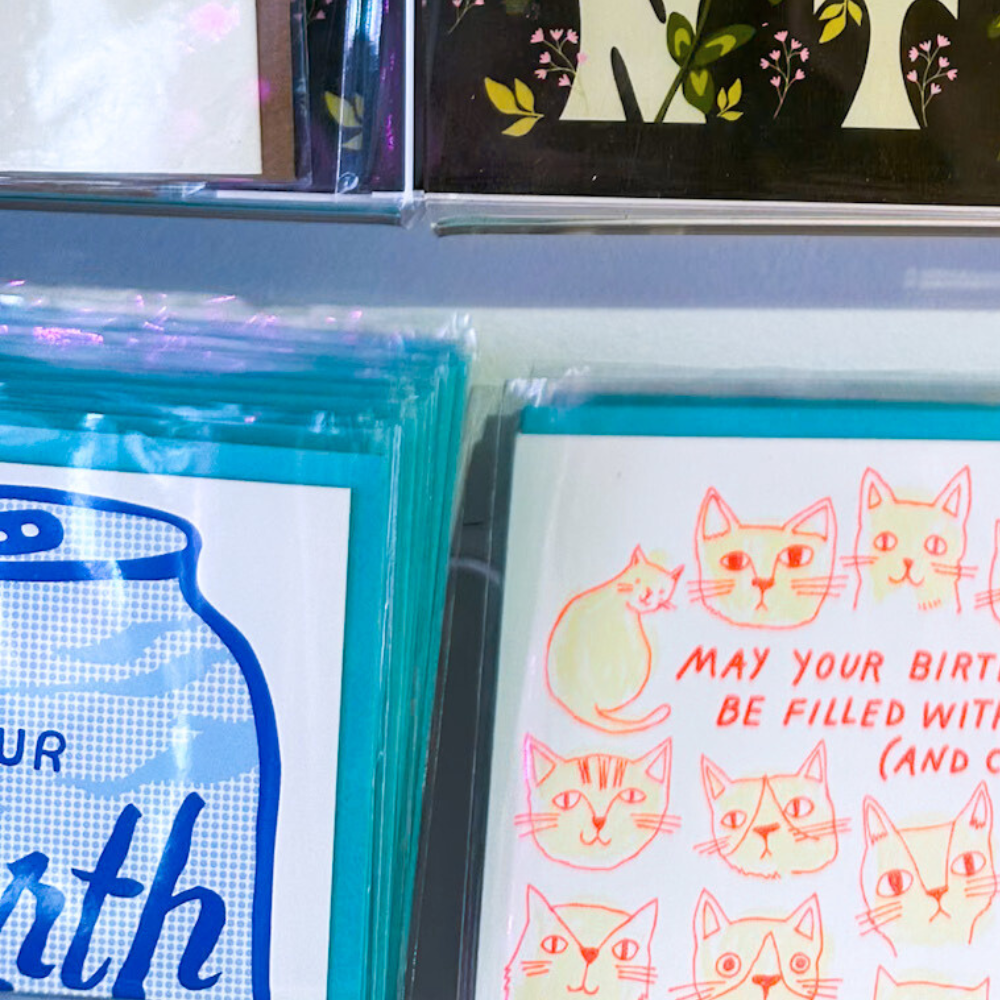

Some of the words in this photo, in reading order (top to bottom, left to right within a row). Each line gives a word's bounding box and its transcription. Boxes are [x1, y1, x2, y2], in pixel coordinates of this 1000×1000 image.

[676, 646, 770, 681] MAY
[792, 648, 885, 687] YOUR
[716, 695, 766, 728] BE
[783, 697, 905, 728] FILLED
[879, 736, 970, 781] (AND
